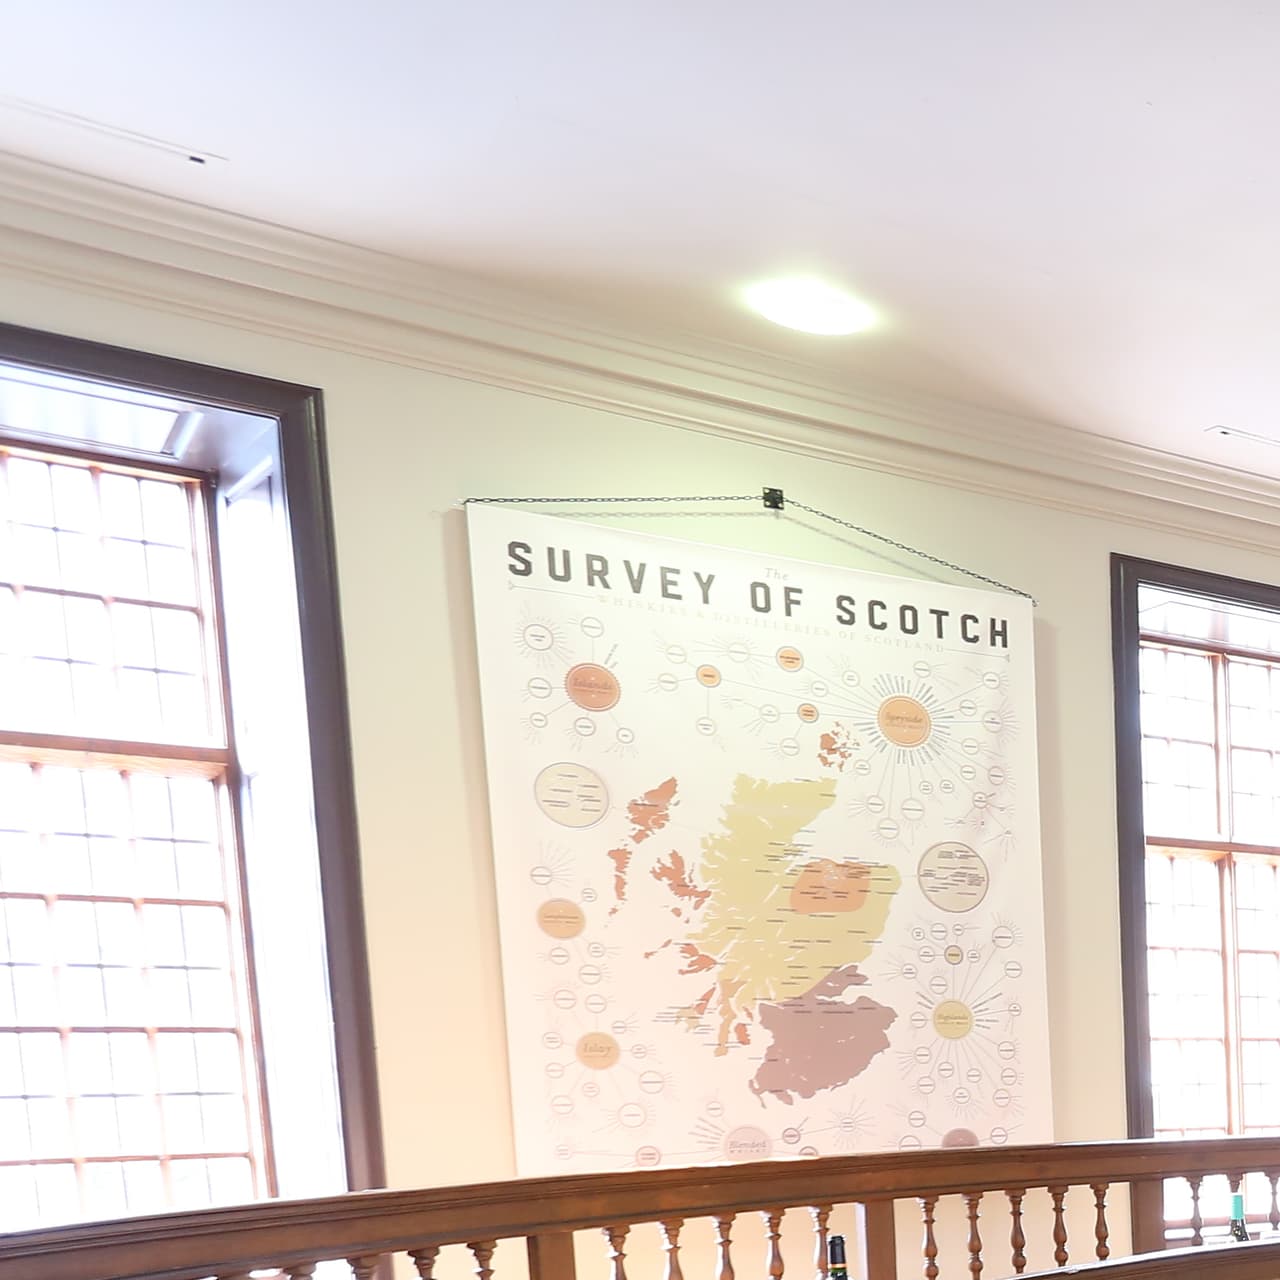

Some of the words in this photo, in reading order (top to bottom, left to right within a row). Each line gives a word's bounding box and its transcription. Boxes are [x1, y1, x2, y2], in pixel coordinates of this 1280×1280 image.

[507, 541, 716, 605] SURVEY
[749, 581, 803, 617] OF
[836, 594, 1009, 649] SCOTCH
